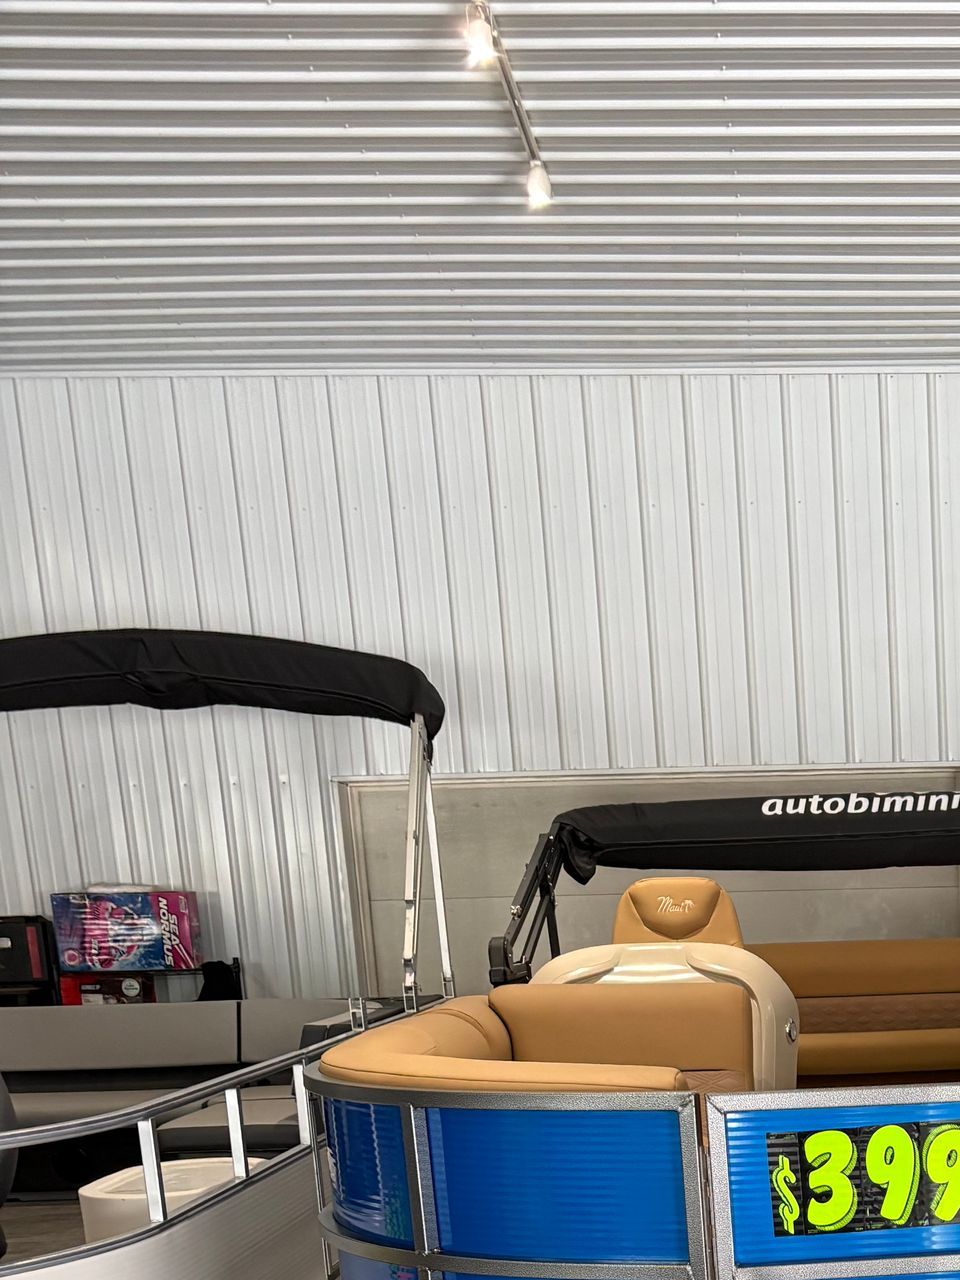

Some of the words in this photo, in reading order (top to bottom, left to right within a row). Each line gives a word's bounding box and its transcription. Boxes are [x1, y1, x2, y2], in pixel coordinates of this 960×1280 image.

[761, 792, 960, 816] autobimini
[656, 896, 685, 913] Maui
[158, 896, 175, 967] NORMUS
[168, 913, 181, 945] SEA
